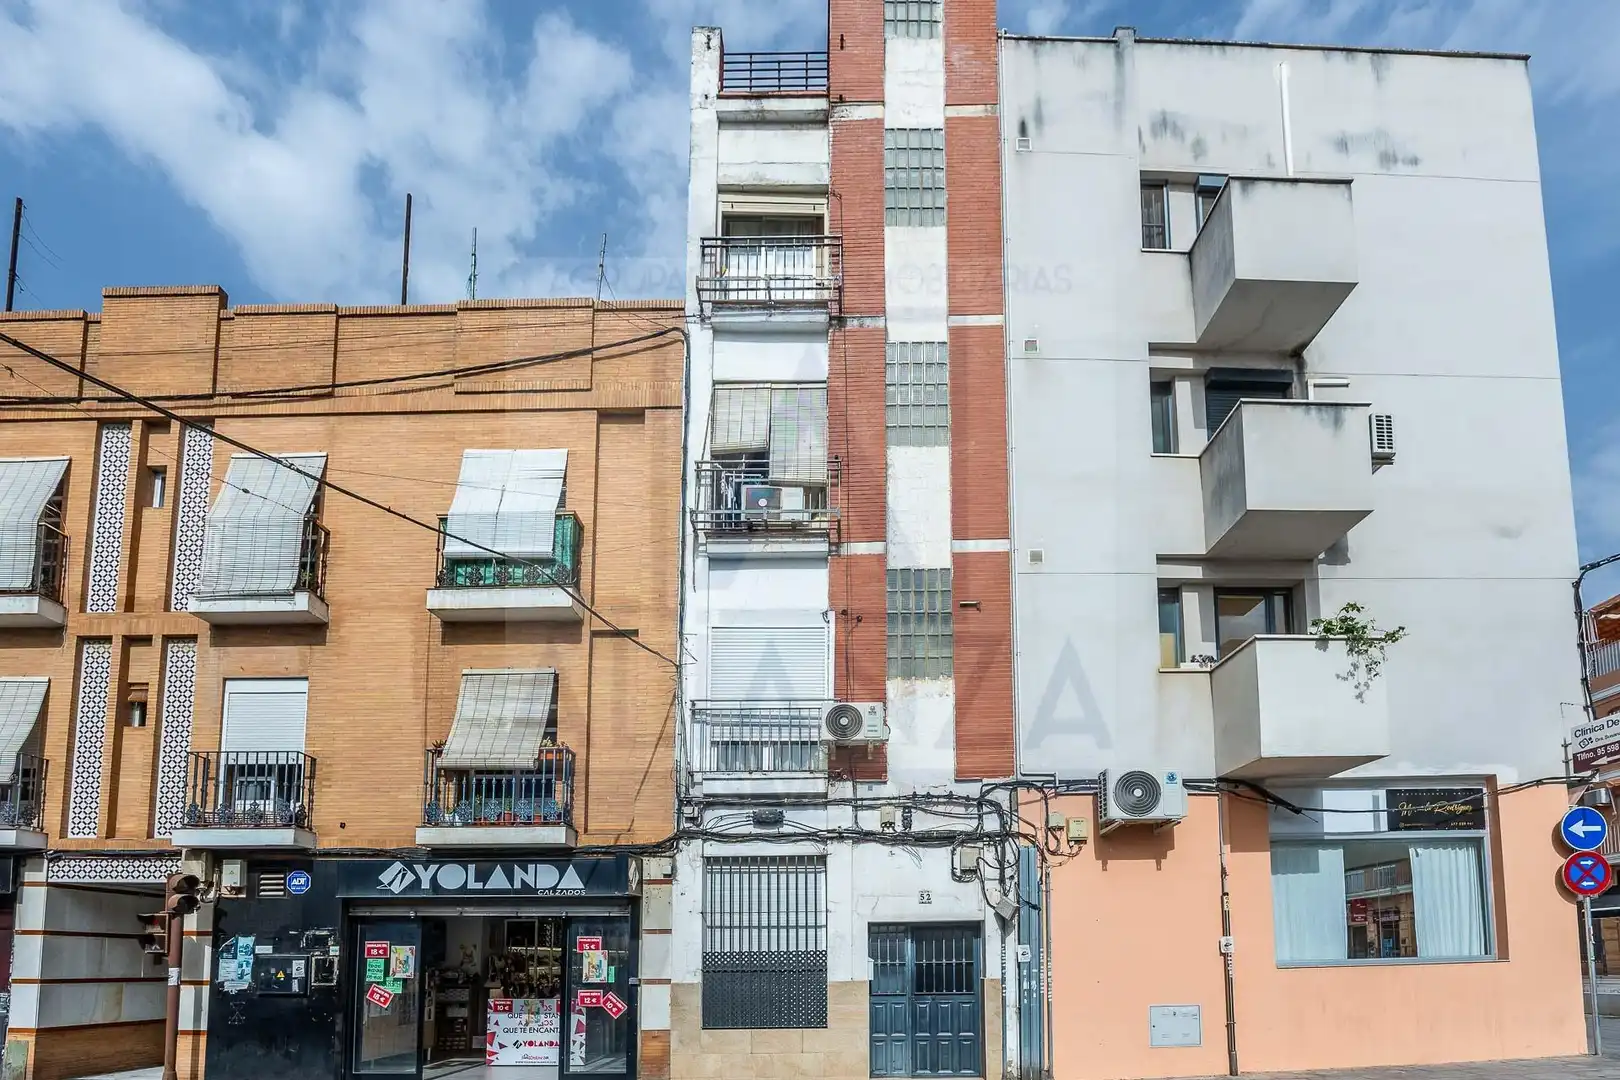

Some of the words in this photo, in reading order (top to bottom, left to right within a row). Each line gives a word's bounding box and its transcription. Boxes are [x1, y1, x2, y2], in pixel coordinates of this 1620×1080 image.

[413, 863, 585, 889] YOLANDA
[291, 877, 307, 885] ADT
[920, 893, 932, 901] 52
